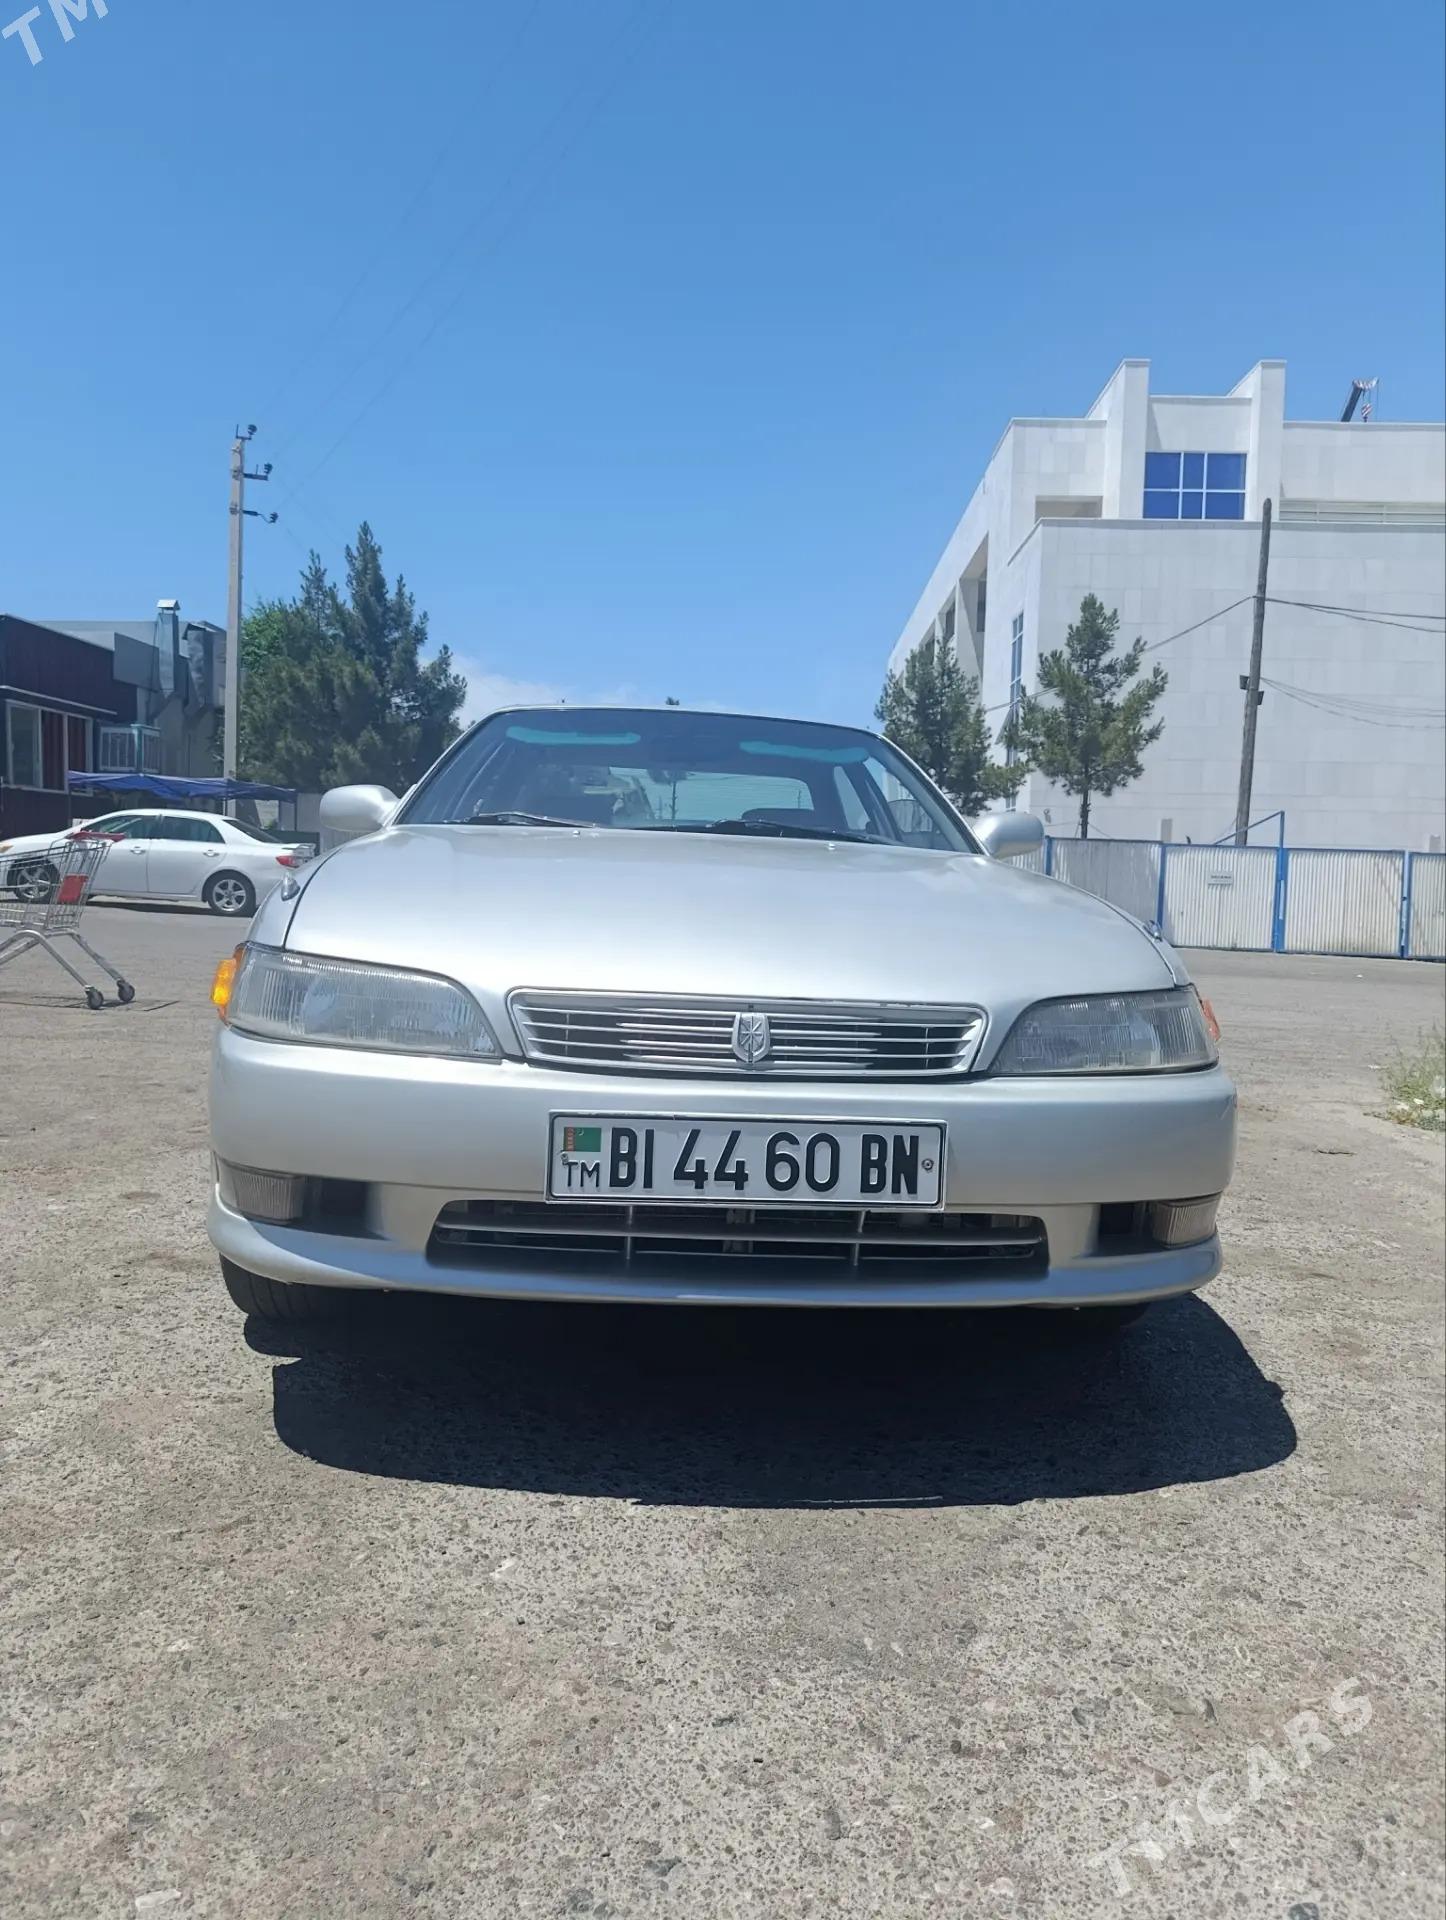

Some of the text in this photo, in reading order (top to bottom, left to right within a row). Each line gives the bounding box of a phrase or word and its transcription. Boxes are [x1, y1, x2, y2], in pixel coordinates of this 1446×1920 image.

[565, 1160, 600, 1188] TM
[609, 1126, 920, 1195] BI 44 60 BN
